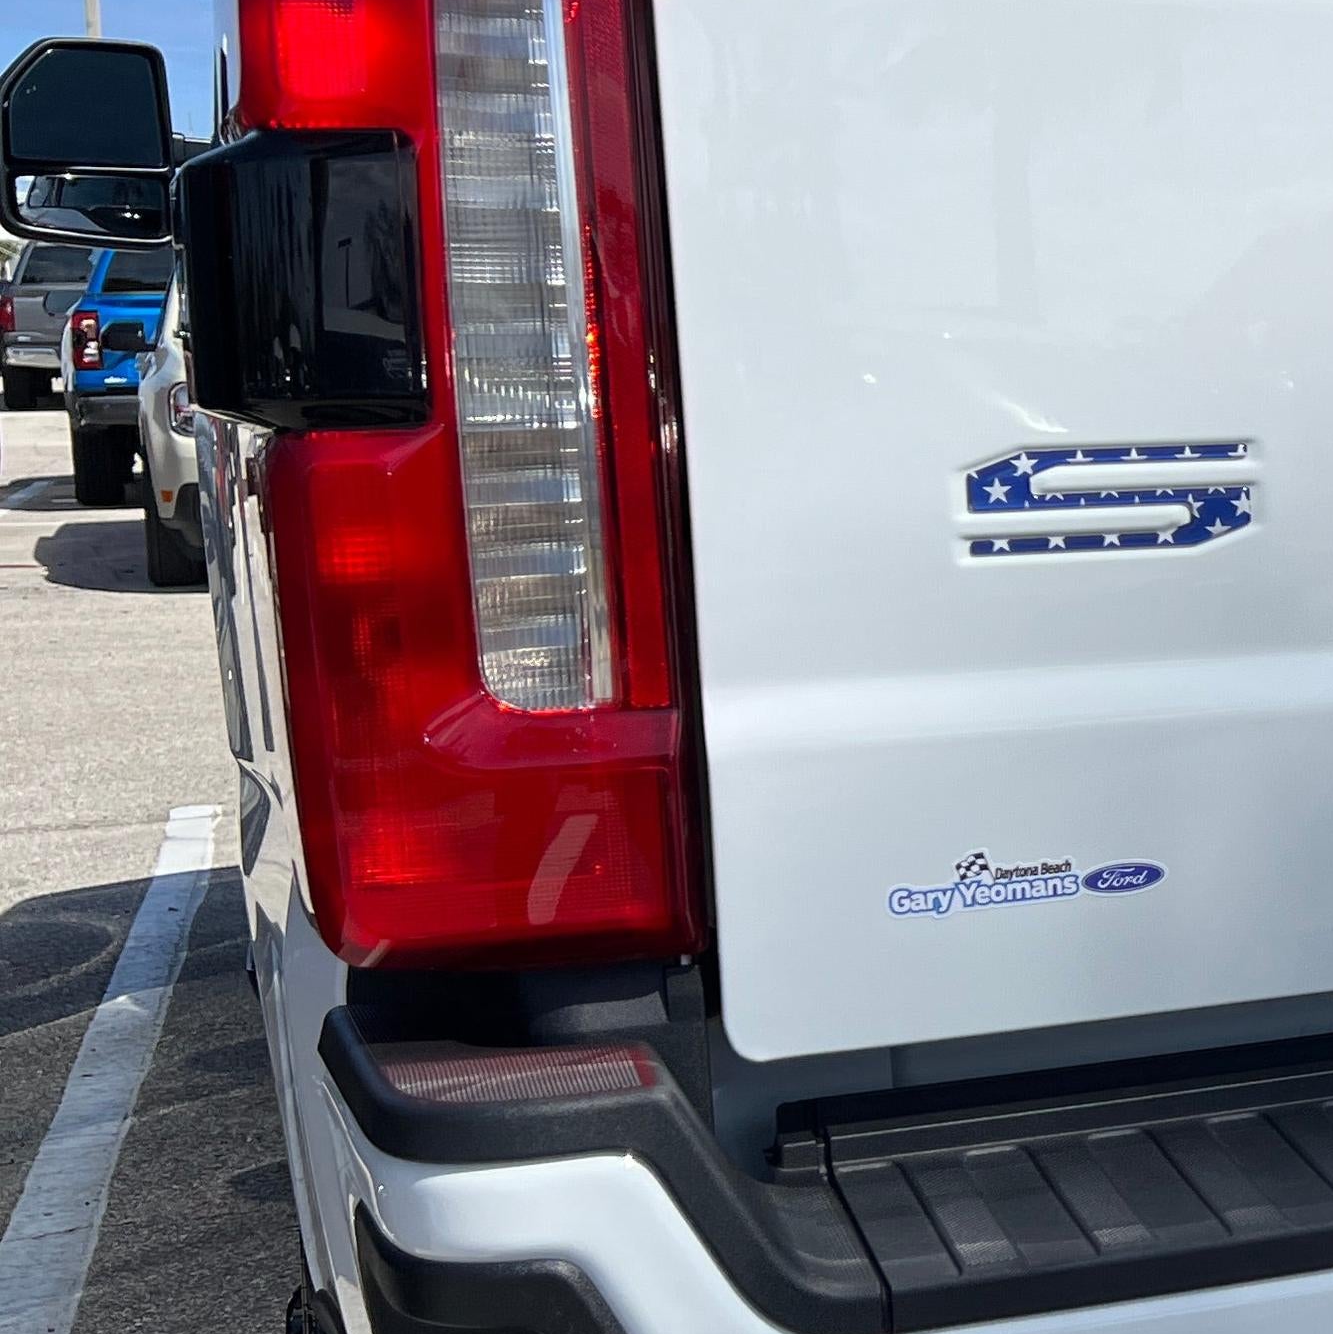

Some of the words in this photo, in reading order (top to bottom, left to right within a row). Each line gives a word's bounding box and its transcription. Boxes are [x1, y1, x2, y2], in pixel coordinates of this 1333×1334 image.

[995, 863, 1039, 880] Daytona
[1040, 859, 1072, 874] Beach
[889, 887, 955, 914] Gary
[955, 873, 1080, 907] Yeomans
[1096, 866, 1148, 888] Ford
